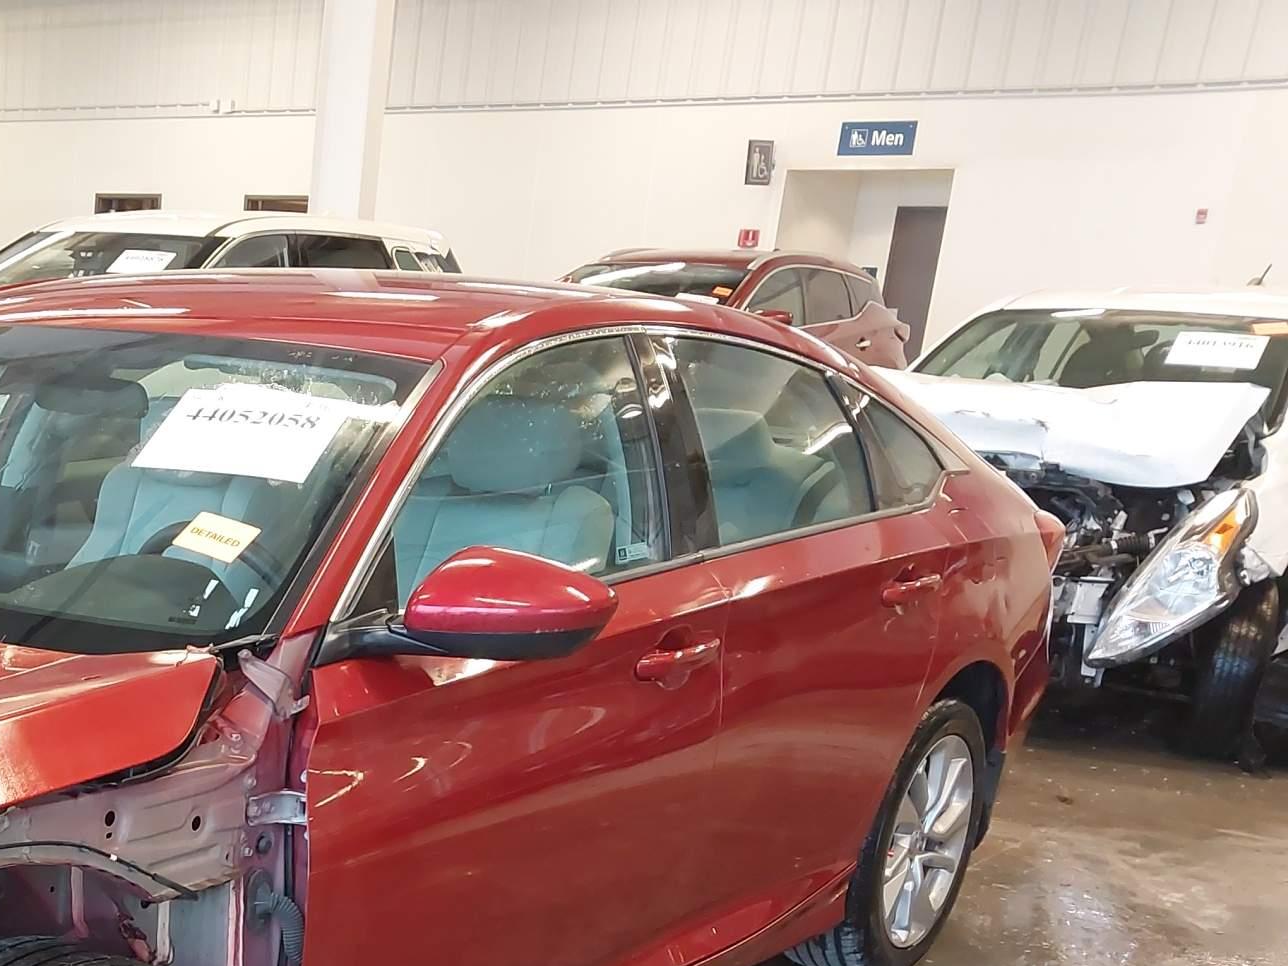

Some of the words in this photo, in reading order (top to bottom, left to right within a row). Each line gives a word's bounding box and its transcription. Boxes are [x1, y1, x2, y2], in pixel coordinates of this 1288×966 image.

[870, 129, 905, 146] Men
[185, 407, 321, 429] 44052058
[189, 526, 241, 548] DETAILED
